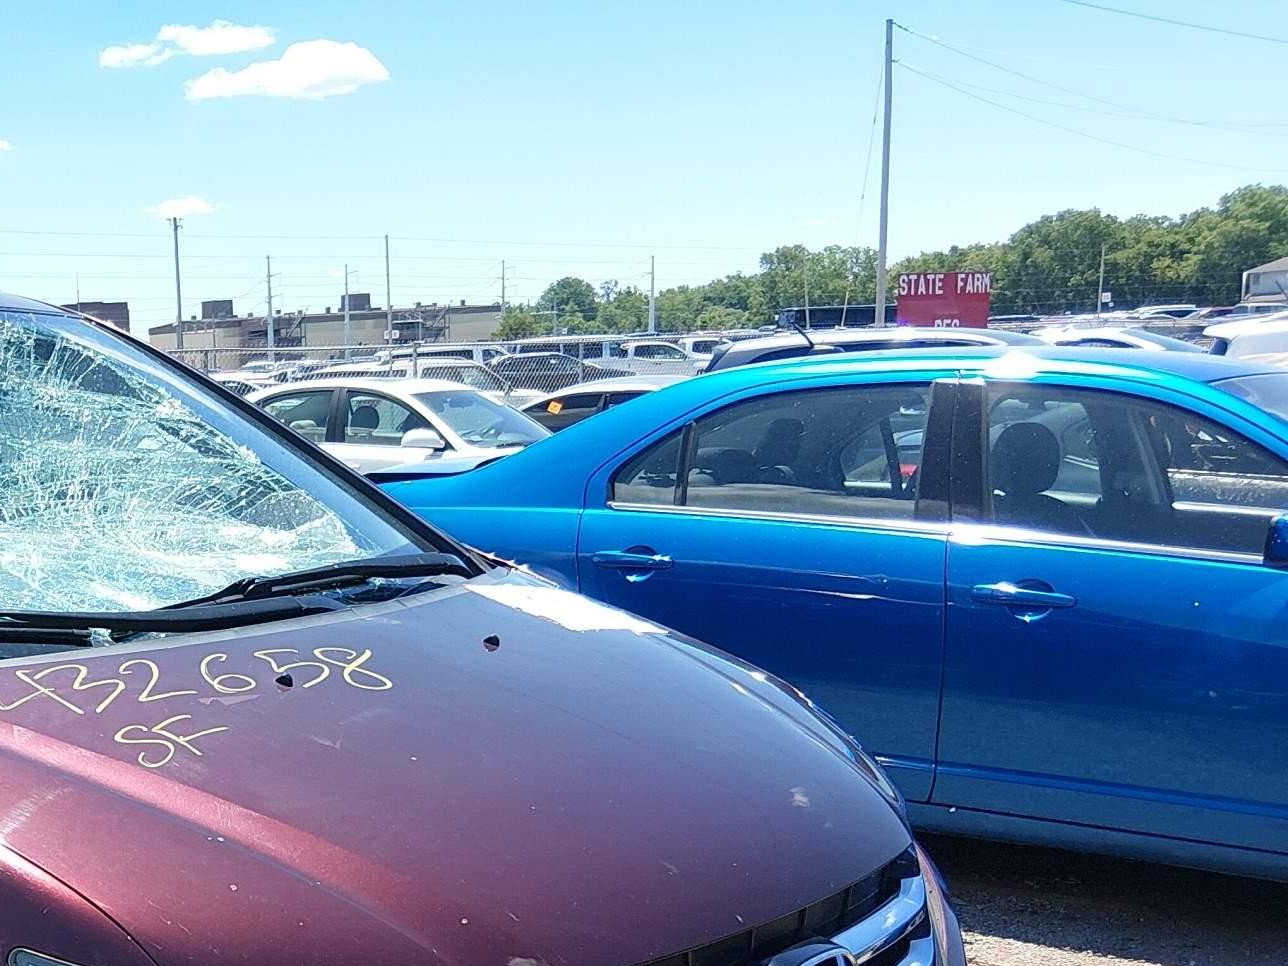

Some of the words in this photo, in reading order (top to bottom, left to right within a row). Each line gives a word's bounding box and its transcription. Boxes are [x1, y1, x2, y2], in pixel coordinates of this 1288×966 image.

[899, 273, 944, 295] STATE
[957, 273, 991, 294] FARM
[113, 714, 229, 769] SF
